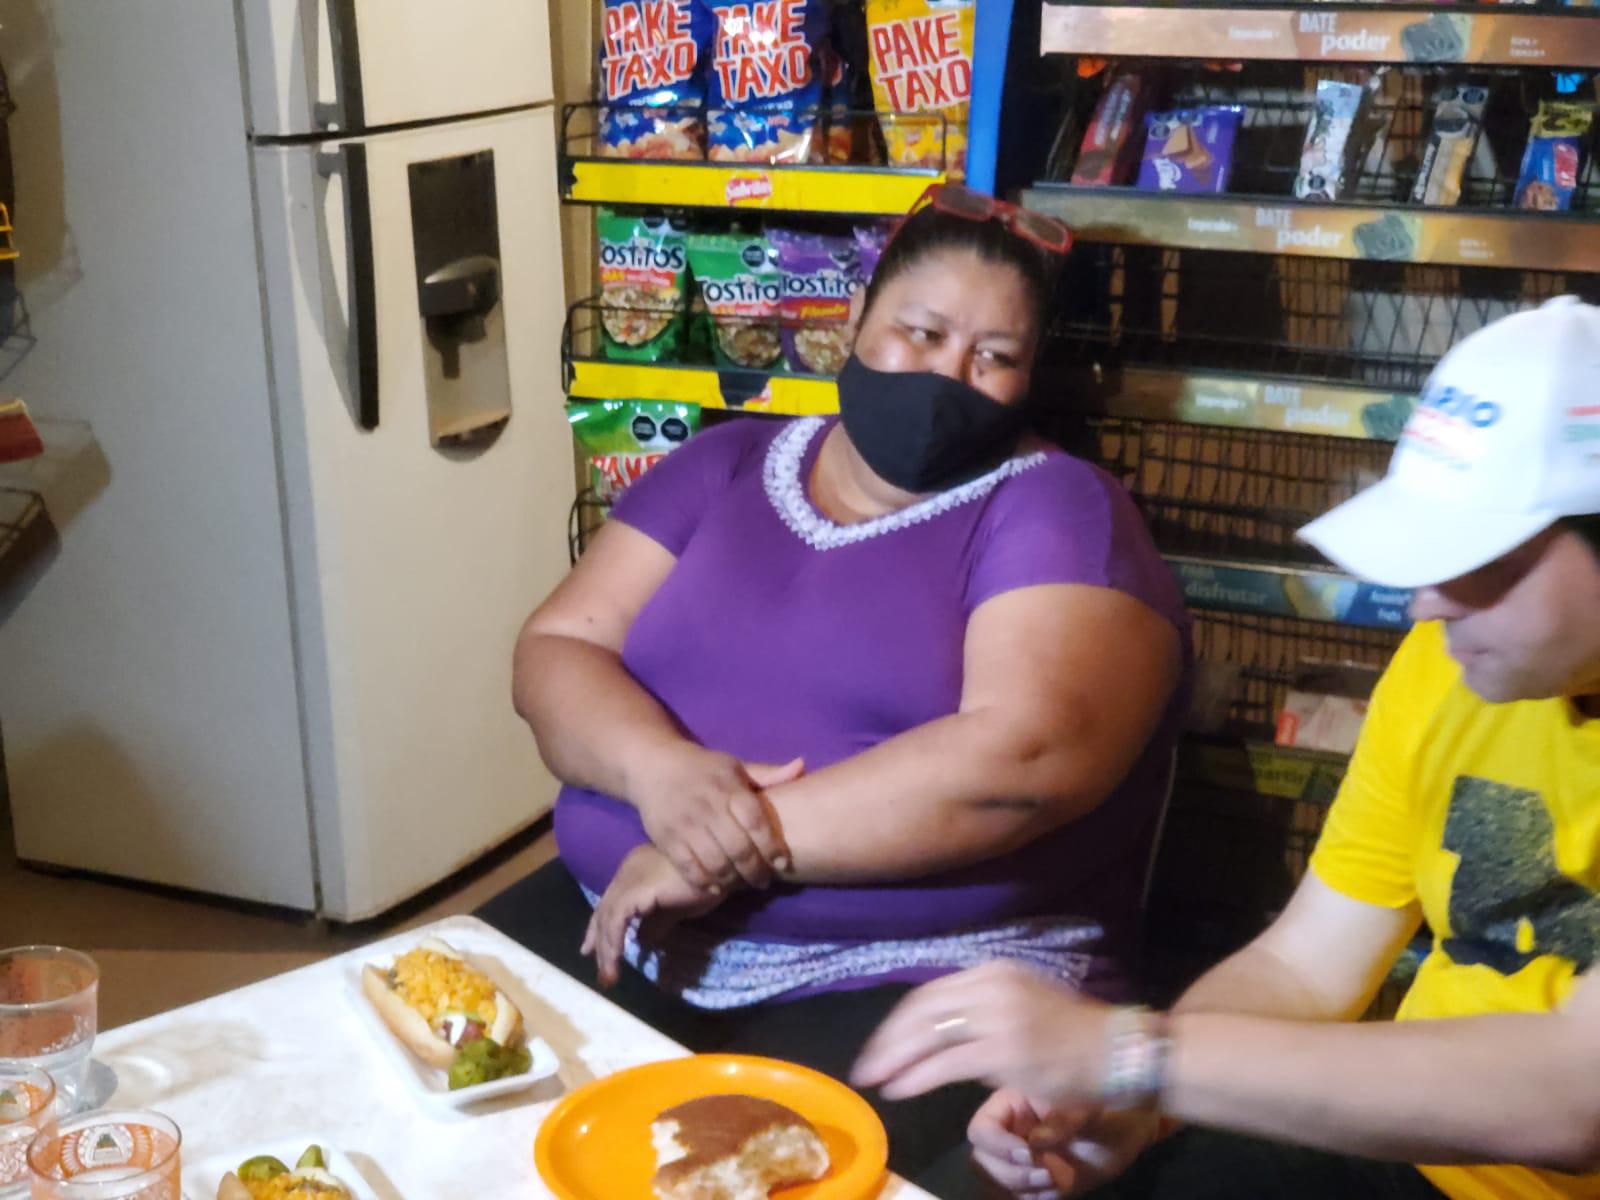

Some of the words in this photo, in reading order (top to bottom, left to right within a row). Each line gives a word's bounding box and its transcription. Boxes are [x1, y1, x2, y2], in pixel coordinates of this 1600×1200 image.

[604, 0, 691, 56] PAKE
[713, 0, 807, 58] PAKE
[872, 13, 960, 73] PAKE
[1320, 28, 1391, 56] poder
[603, 41, 697, 99] TAXO
[714, 44, 811, 101] TAXO
[878, 59, 972, 114] TAXO
[600, 239, 684, 269] ostitos
[1276, 224, 1345, 250] poder
